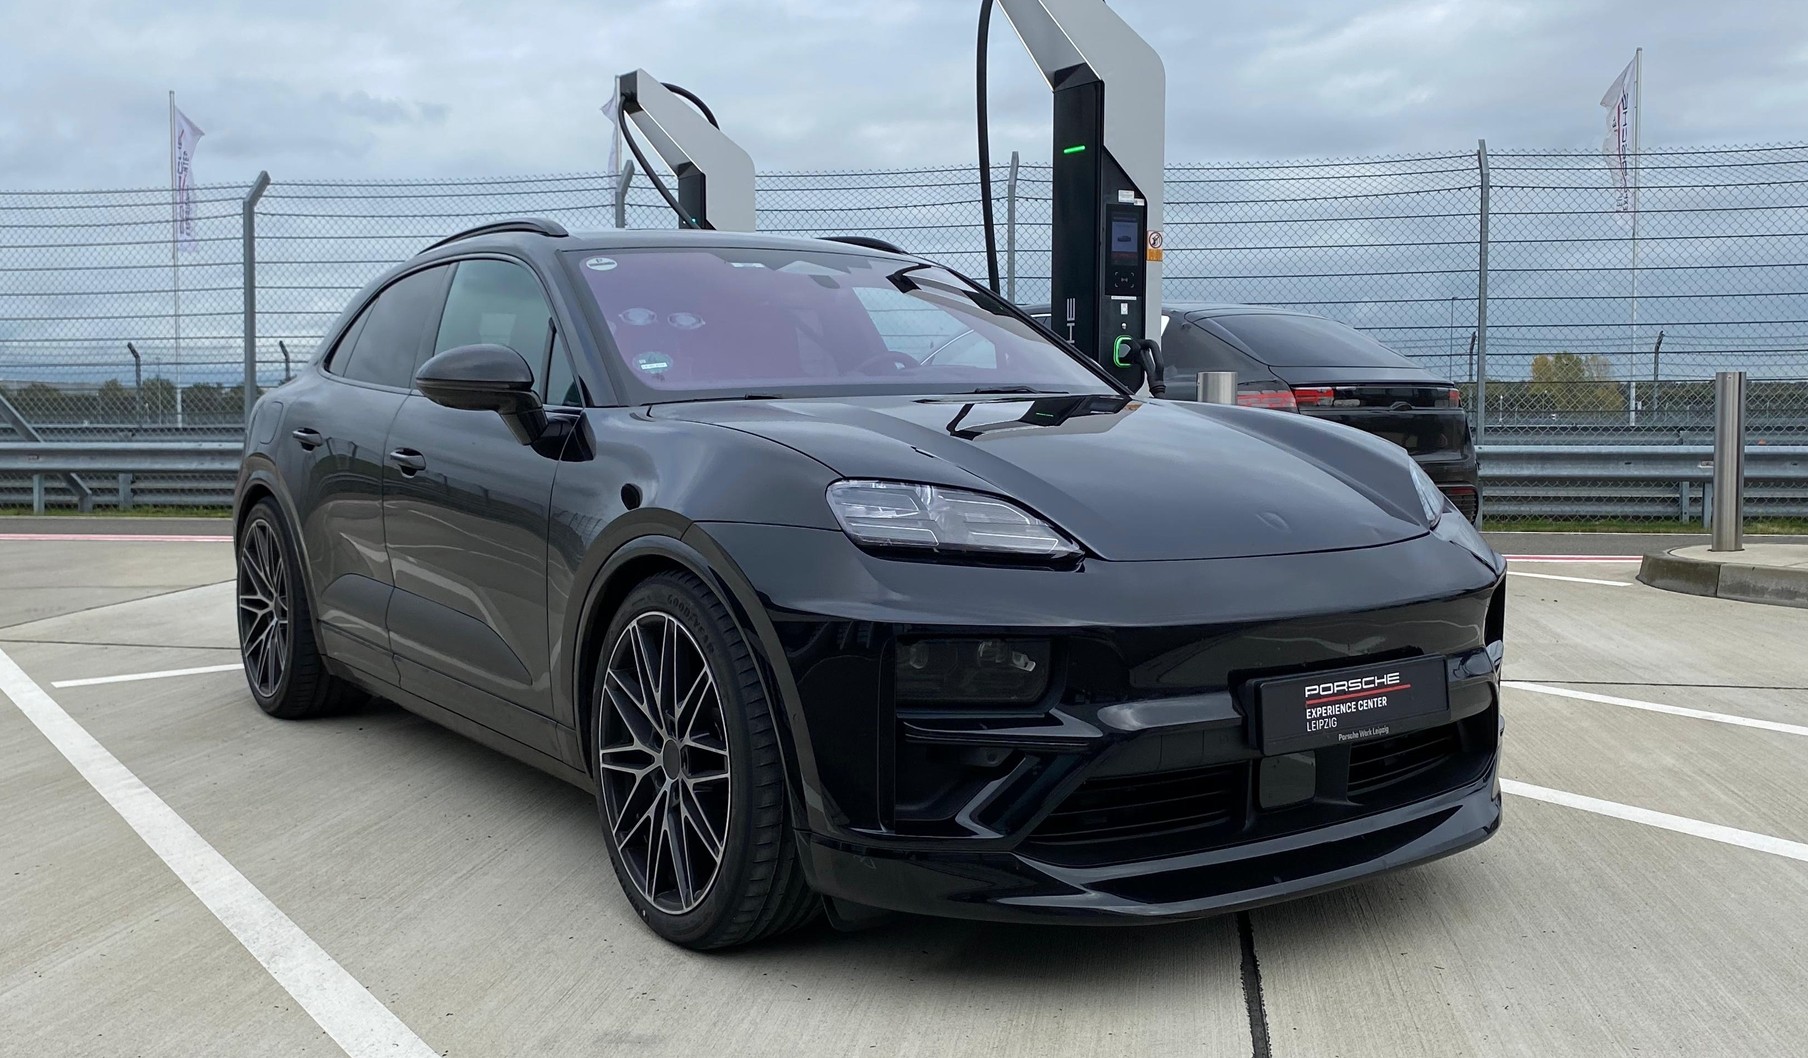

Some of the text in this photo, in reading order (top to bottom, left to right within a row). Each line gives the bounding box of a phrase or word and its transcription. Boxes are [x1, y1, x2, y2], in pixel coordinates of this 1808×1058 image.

[1305, 672, 1400, 698] PORSCHE
[1306, 696, 1388, 719] EXPERIENCE CENTER
[1306, 717, 1338, 732] LEIPZIG
[1338, 731, 1359, 741] Porsche
[1373, 725, 1389, 736] Leipzig
